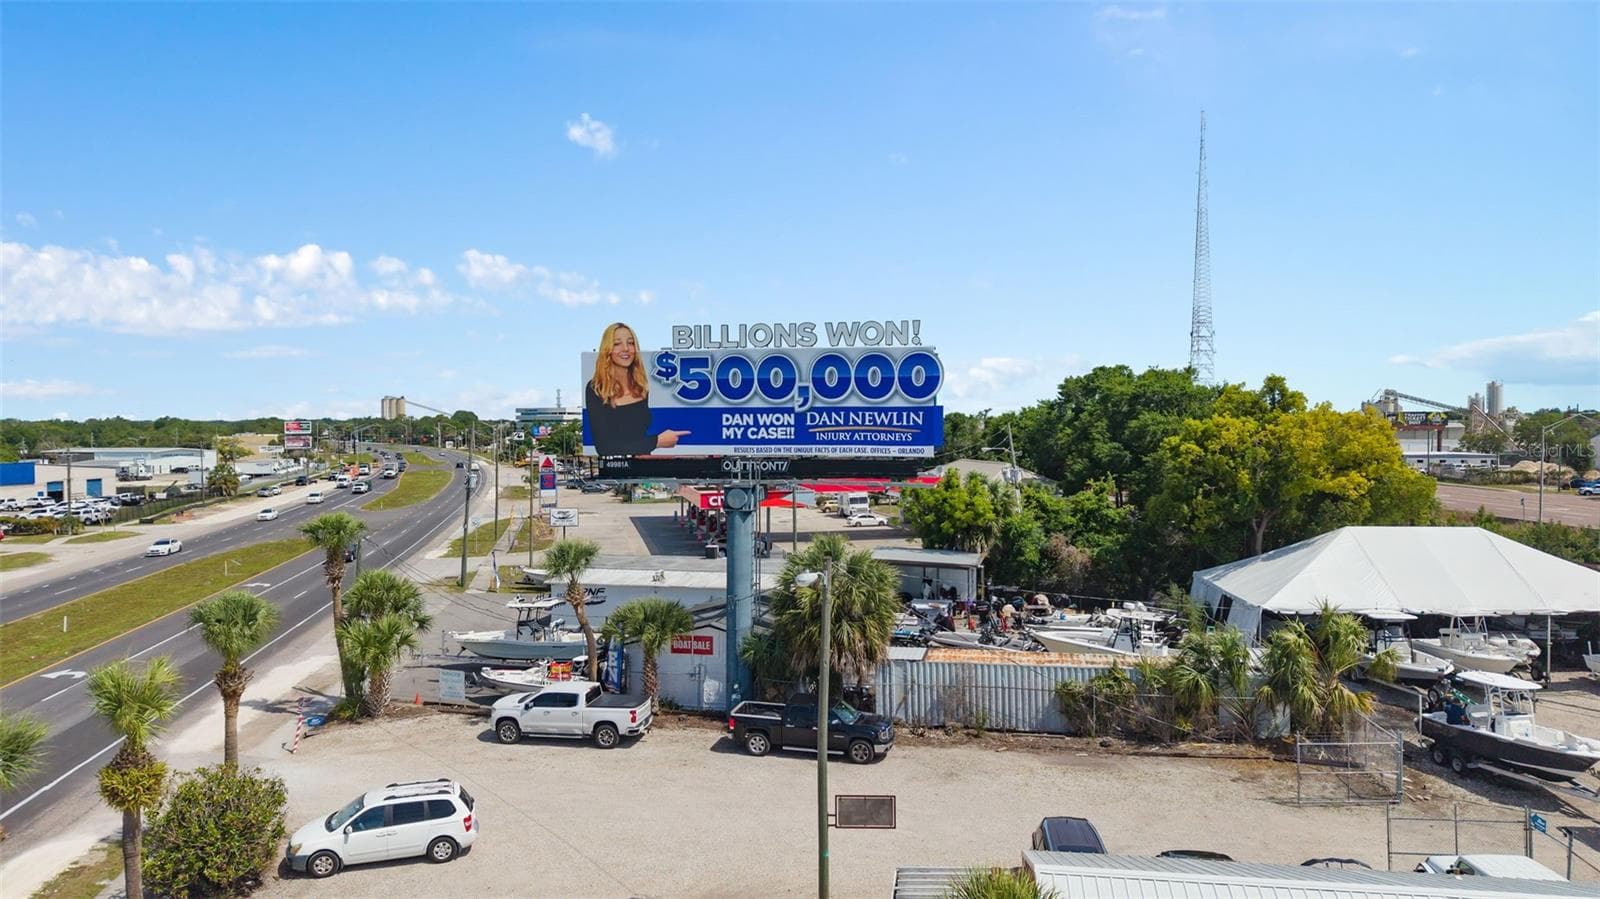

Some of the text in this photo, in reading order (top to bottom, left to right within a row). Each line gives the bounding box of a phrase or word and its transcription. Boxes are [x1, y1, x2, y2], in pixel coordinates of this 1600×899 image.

[672, 319, 922, 349] BILLIONS WON!
[654, 351, 942, 410] $500,000
[722, 413, 795, 425] DAN WON
[806, 411, 924, 425] DAN NEWLIN
[722, 427, 795, 439] MY CASE!!
[816, 432, 912, 441] INJURY ATTORNEYS
[673, 640, 710, 650] BOAT SALE
